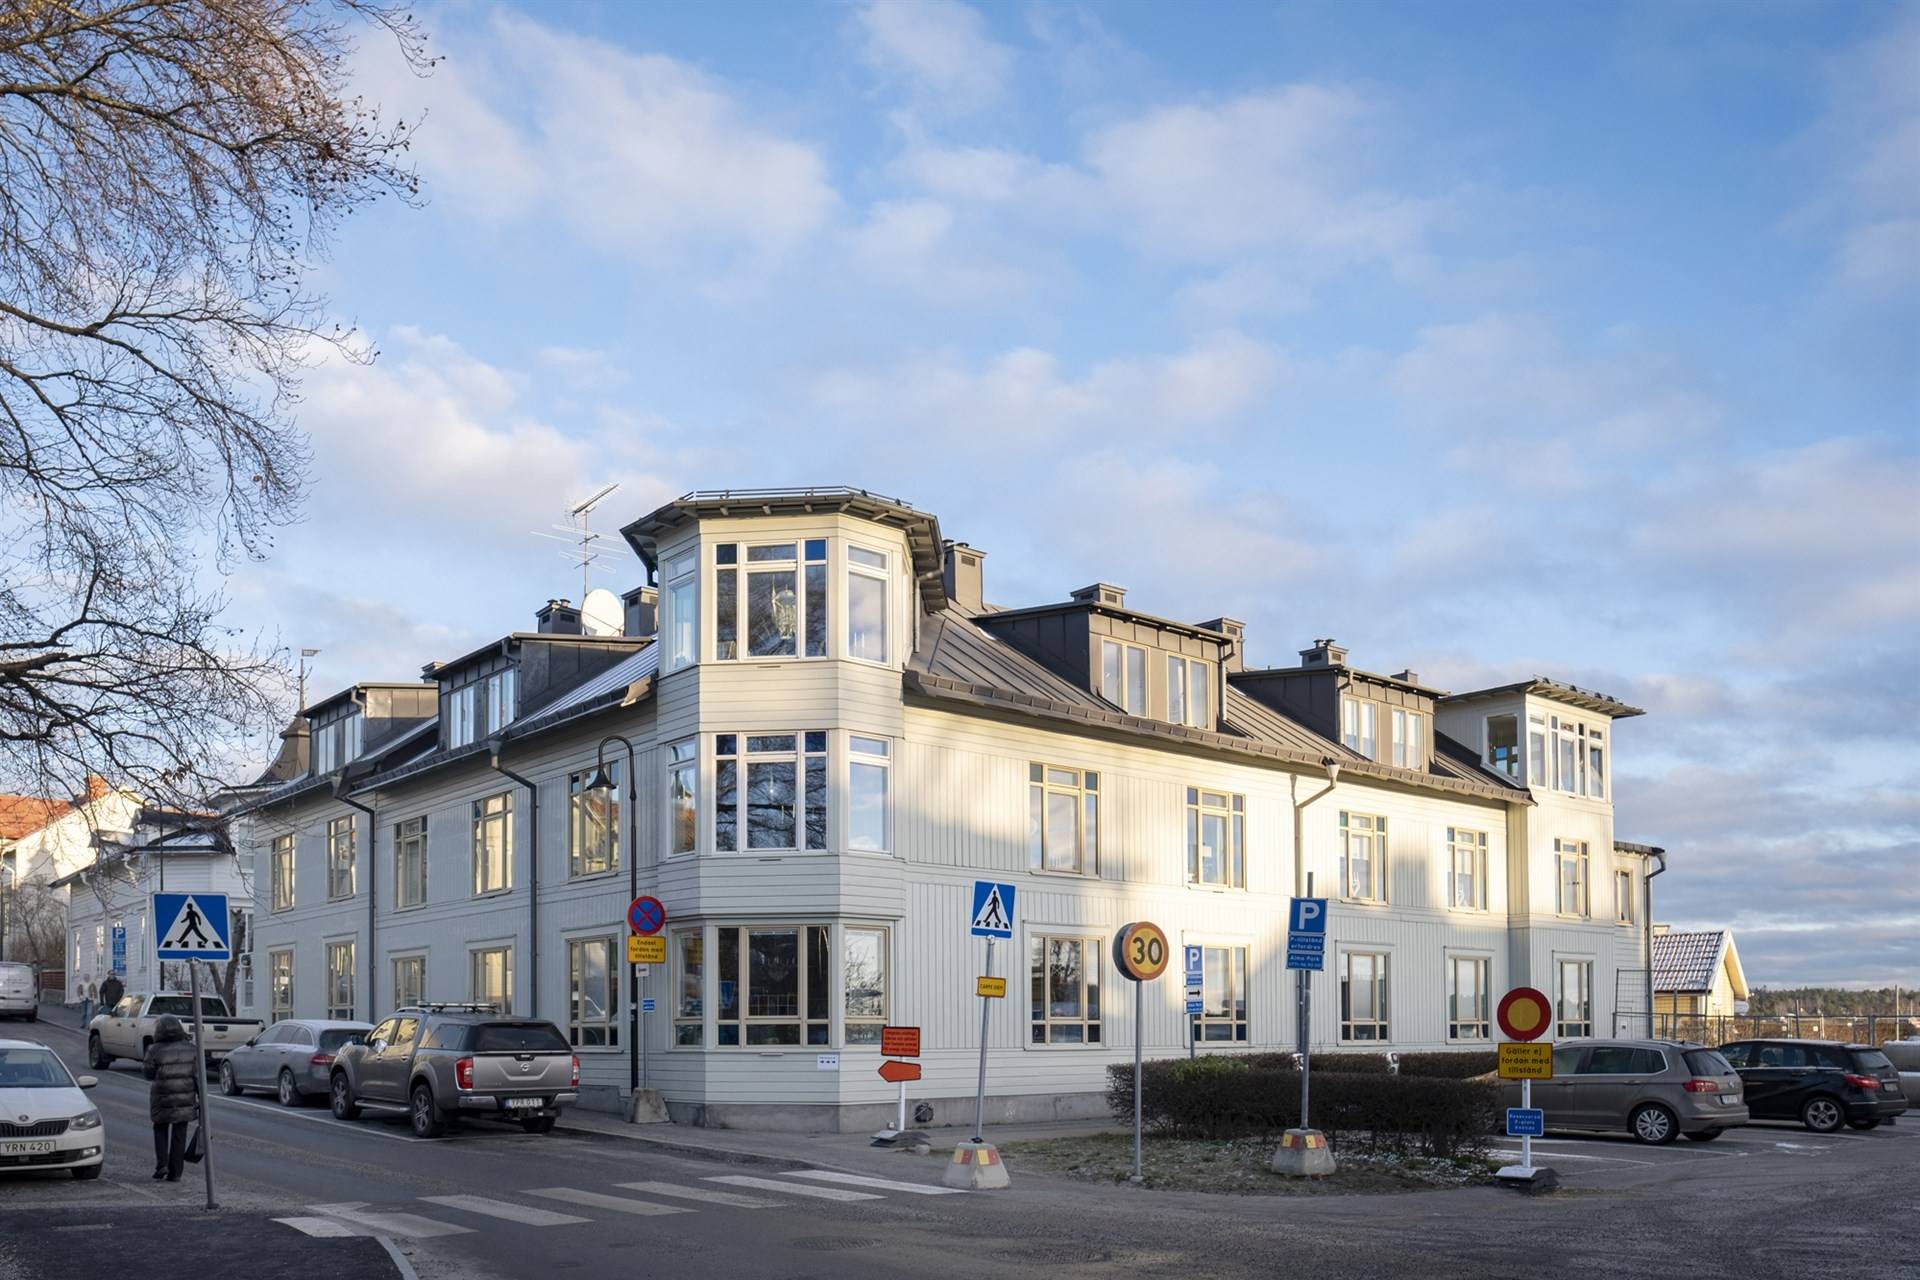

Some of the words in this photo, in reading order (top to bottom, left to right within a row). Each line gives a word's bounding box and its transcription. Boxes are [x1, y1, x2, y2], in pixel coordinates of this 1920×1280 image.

[1299, 902, 1320, 930] P
[1132, 936, 1163, 966] 30
[1190, 948, 1200, 970] P
[1533, 1047, 1542, 1056] ej
[1508, 1066, 1543, 1074] tillstånd
[5, 1143, 26, 1152] YRN
[29, 1142, 50, 1151] 420
